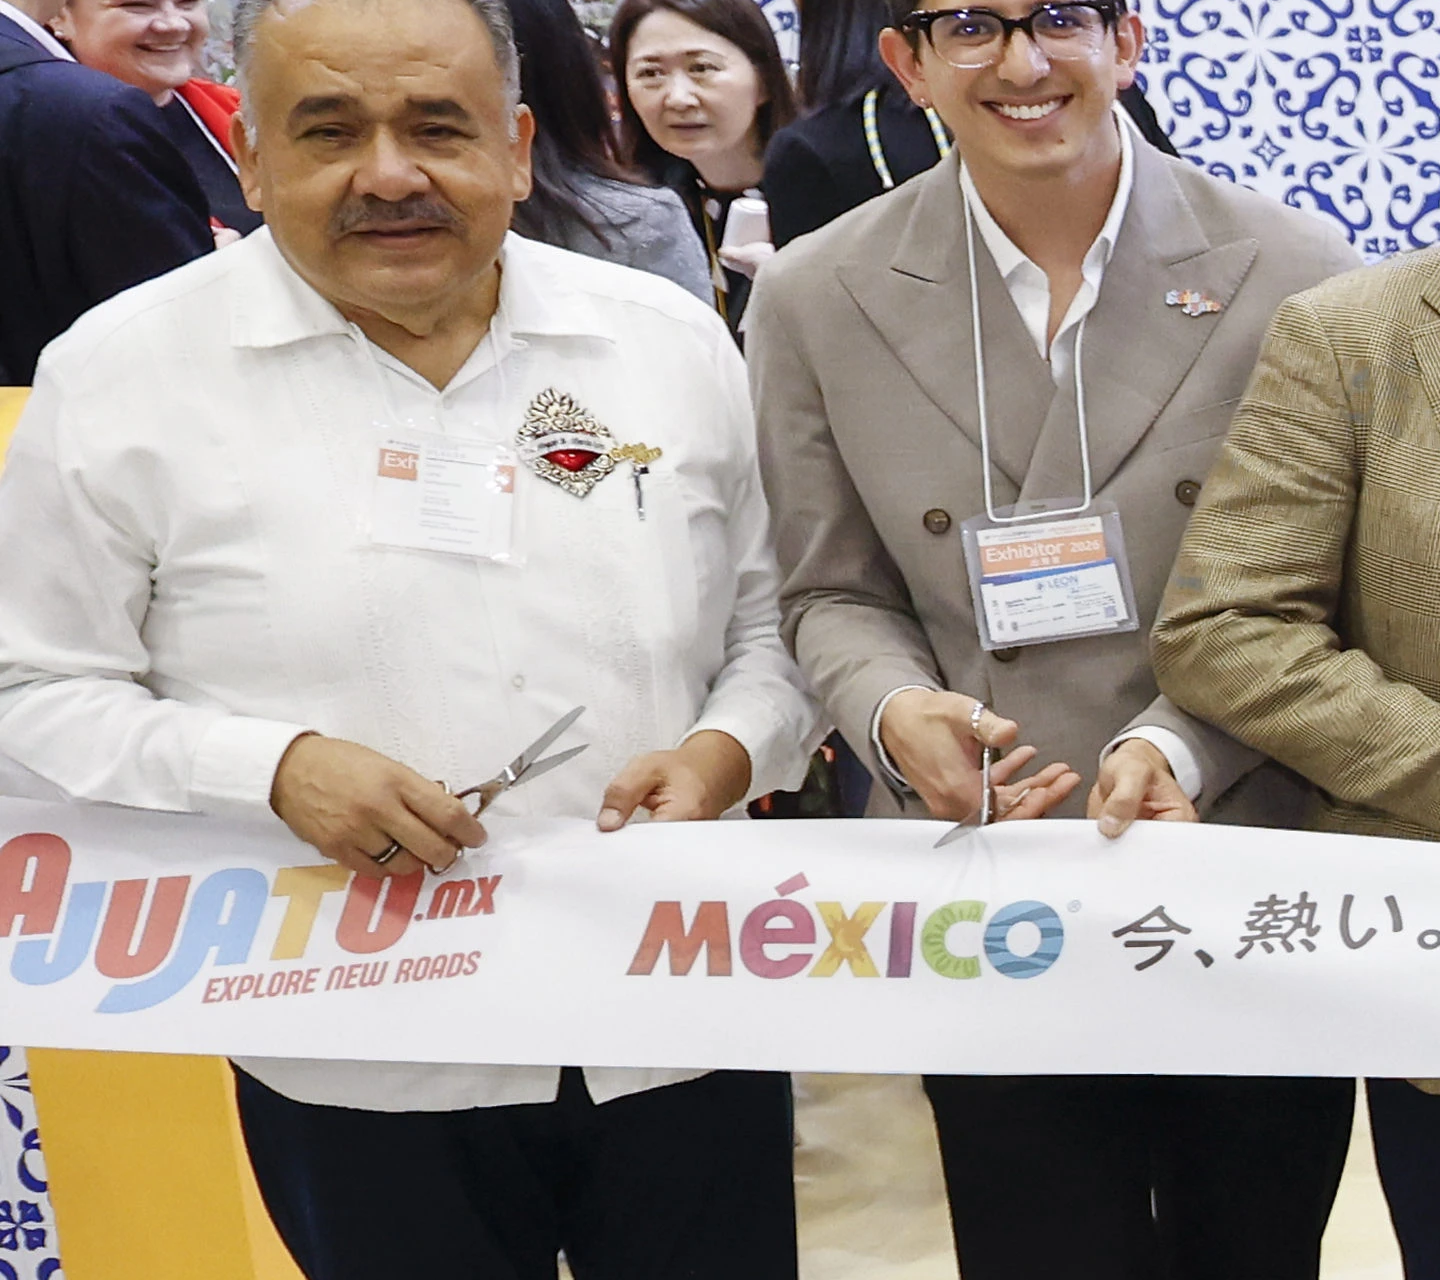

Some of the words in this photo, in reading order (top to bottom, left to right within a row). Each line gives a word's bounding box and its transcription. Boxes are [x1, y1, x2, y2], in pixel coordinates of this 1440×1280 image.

[985, 542, 1066, 563] Exhibitor
[201, 968, 321, 1004] EXPLORE
[324, 961, 389, 991] NEW
[394, 950, 482, 984] ROADS
